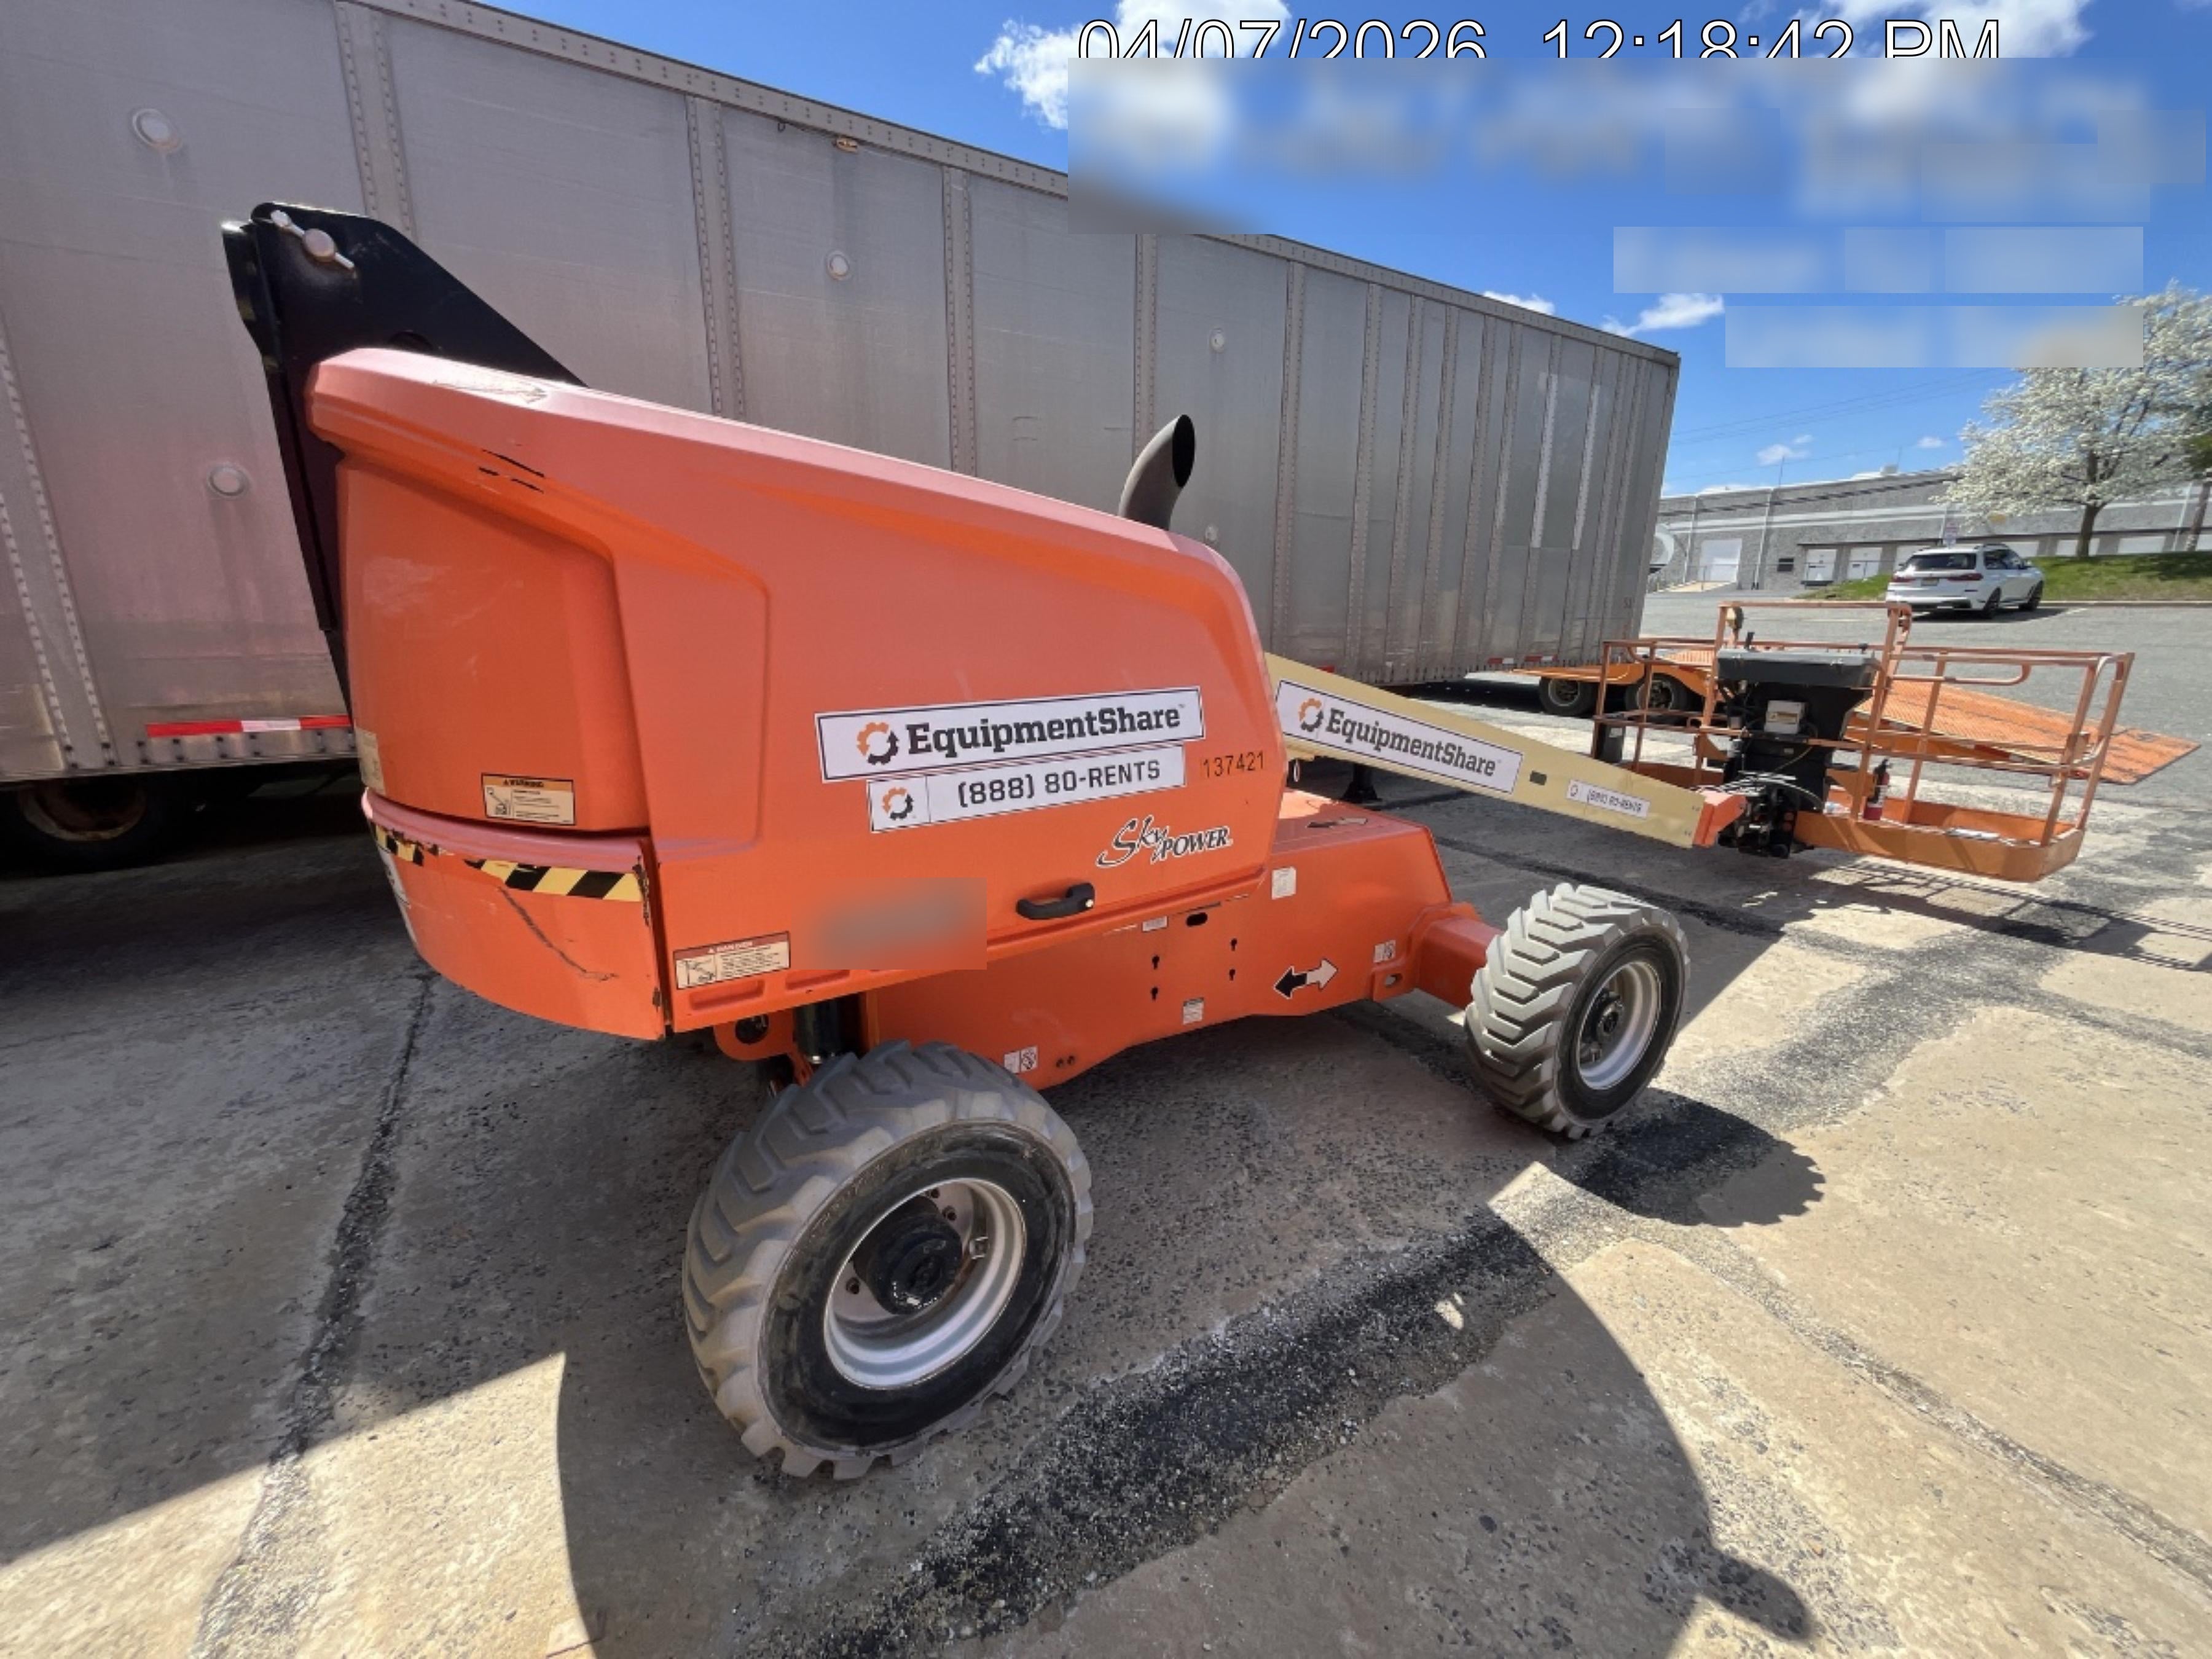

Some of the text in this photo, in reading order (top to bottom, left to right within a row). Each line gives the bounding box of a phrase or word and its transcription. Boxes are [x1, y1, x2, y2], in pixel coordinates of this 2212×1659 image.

[906, 707, 1180, 758] EquipmentShare
[1326, 707, 1496, 777] EquipmentShare
[957, 759, 1160, 807] (888) 80-RENTS
[1202, 750, 1263, 778] 137421
